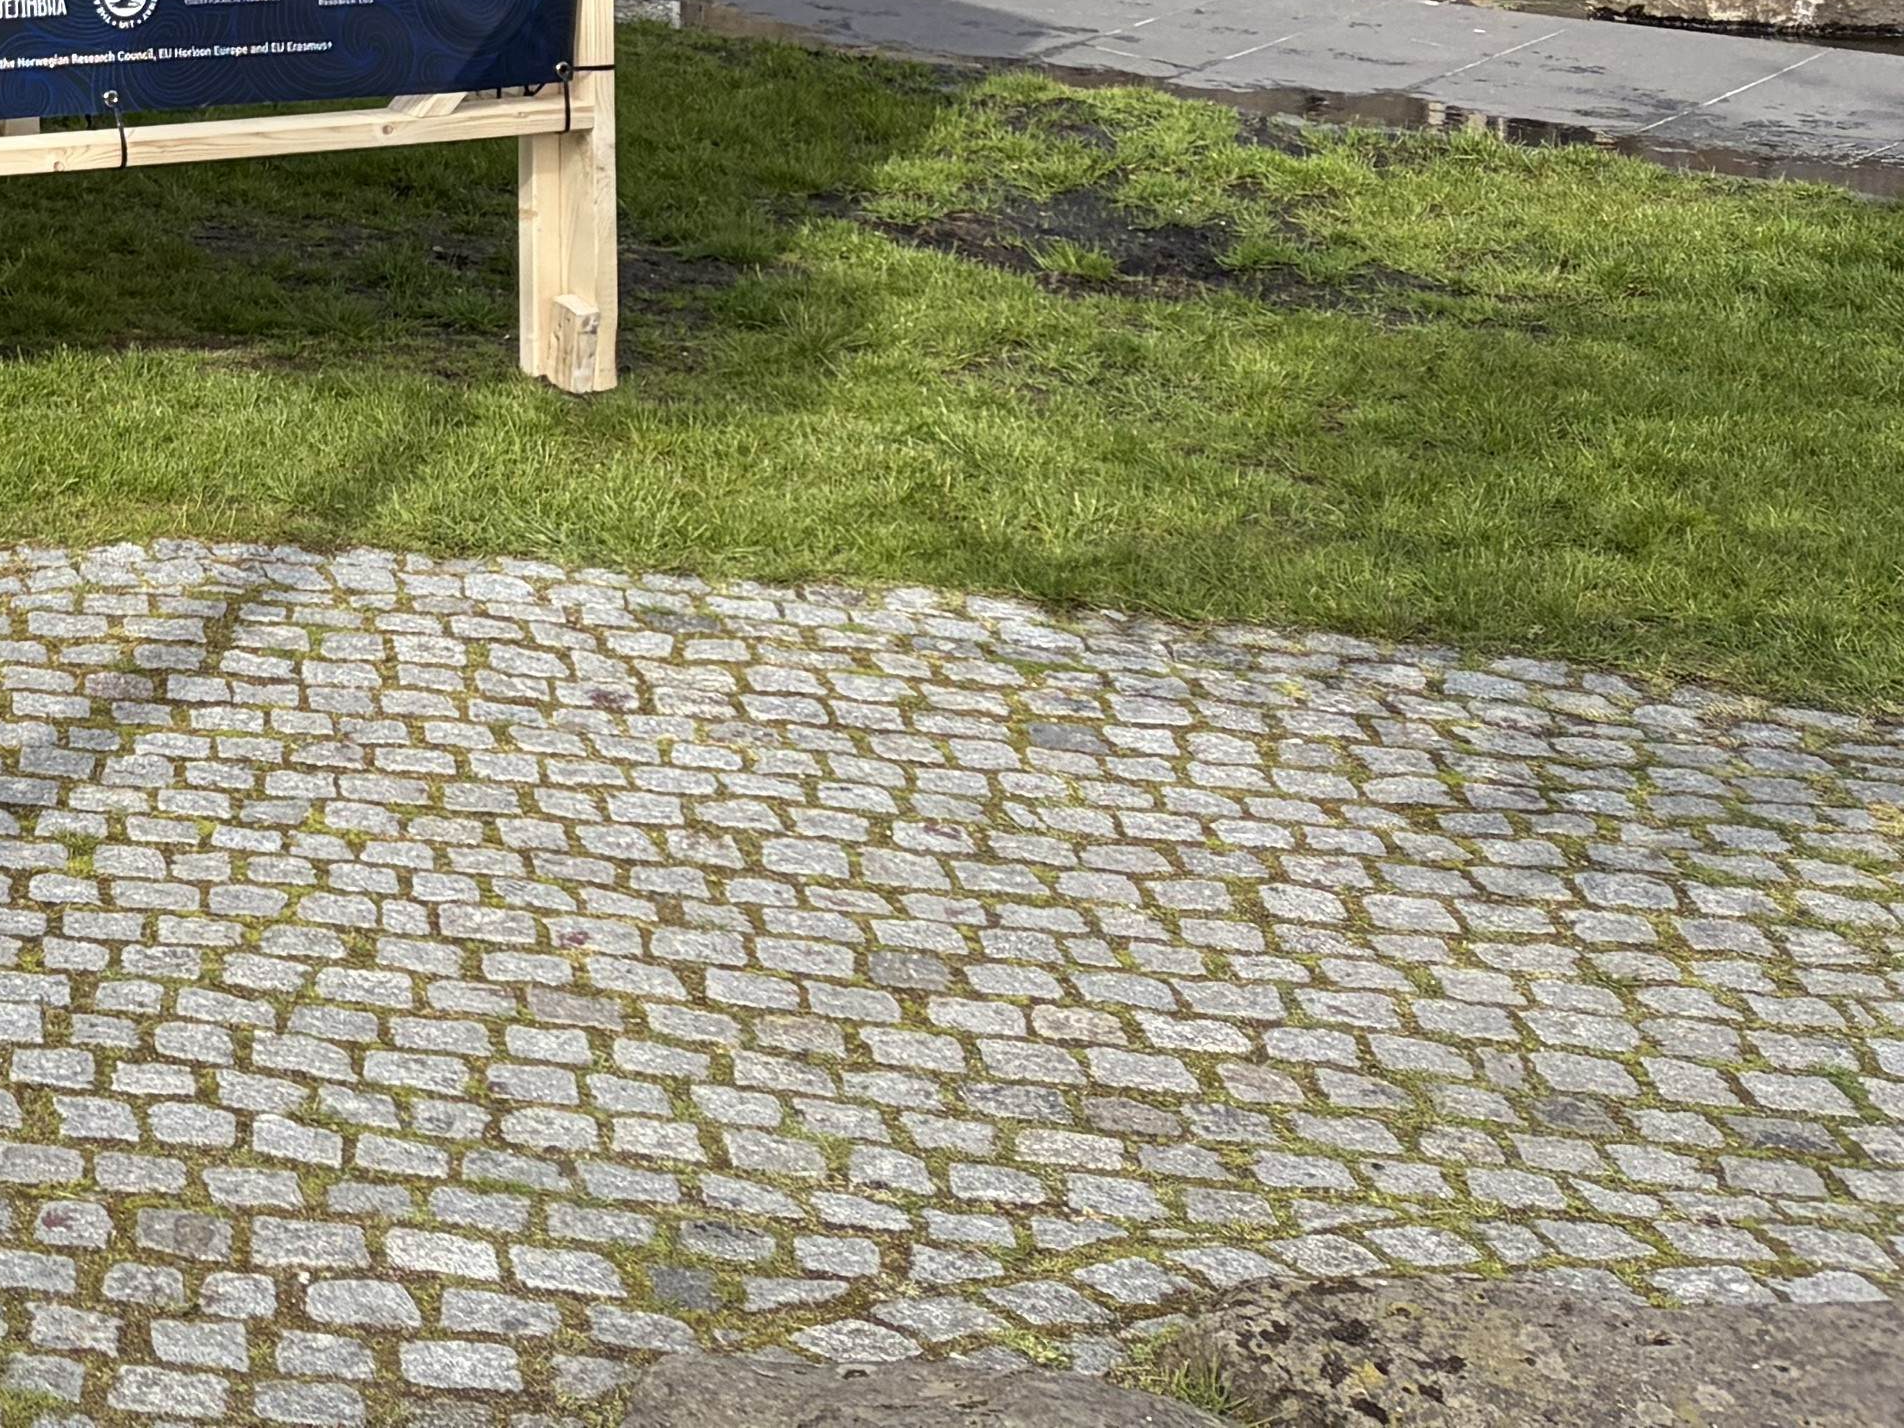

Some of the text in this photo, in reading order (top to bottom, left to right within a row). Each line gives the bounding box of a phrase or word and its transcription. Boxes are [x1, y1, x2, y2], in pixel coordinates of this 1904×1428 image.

[95, 5, 112, 25] THE
[0, 56, 15, 70] the
[17, 54, 69, 69] Norwegian
[71, 50, 116, 65] Research
[117, 47, 157, 62] Council,
[158, 48, 172, 59] EU
[174, 46, 212, 58] Horizon
[213, 44, 248, 57] Europe
[250, 41, 269, 54] and
[270, 42, 285, 53] EU
[286, 40, 332, 53] Erasmus+
